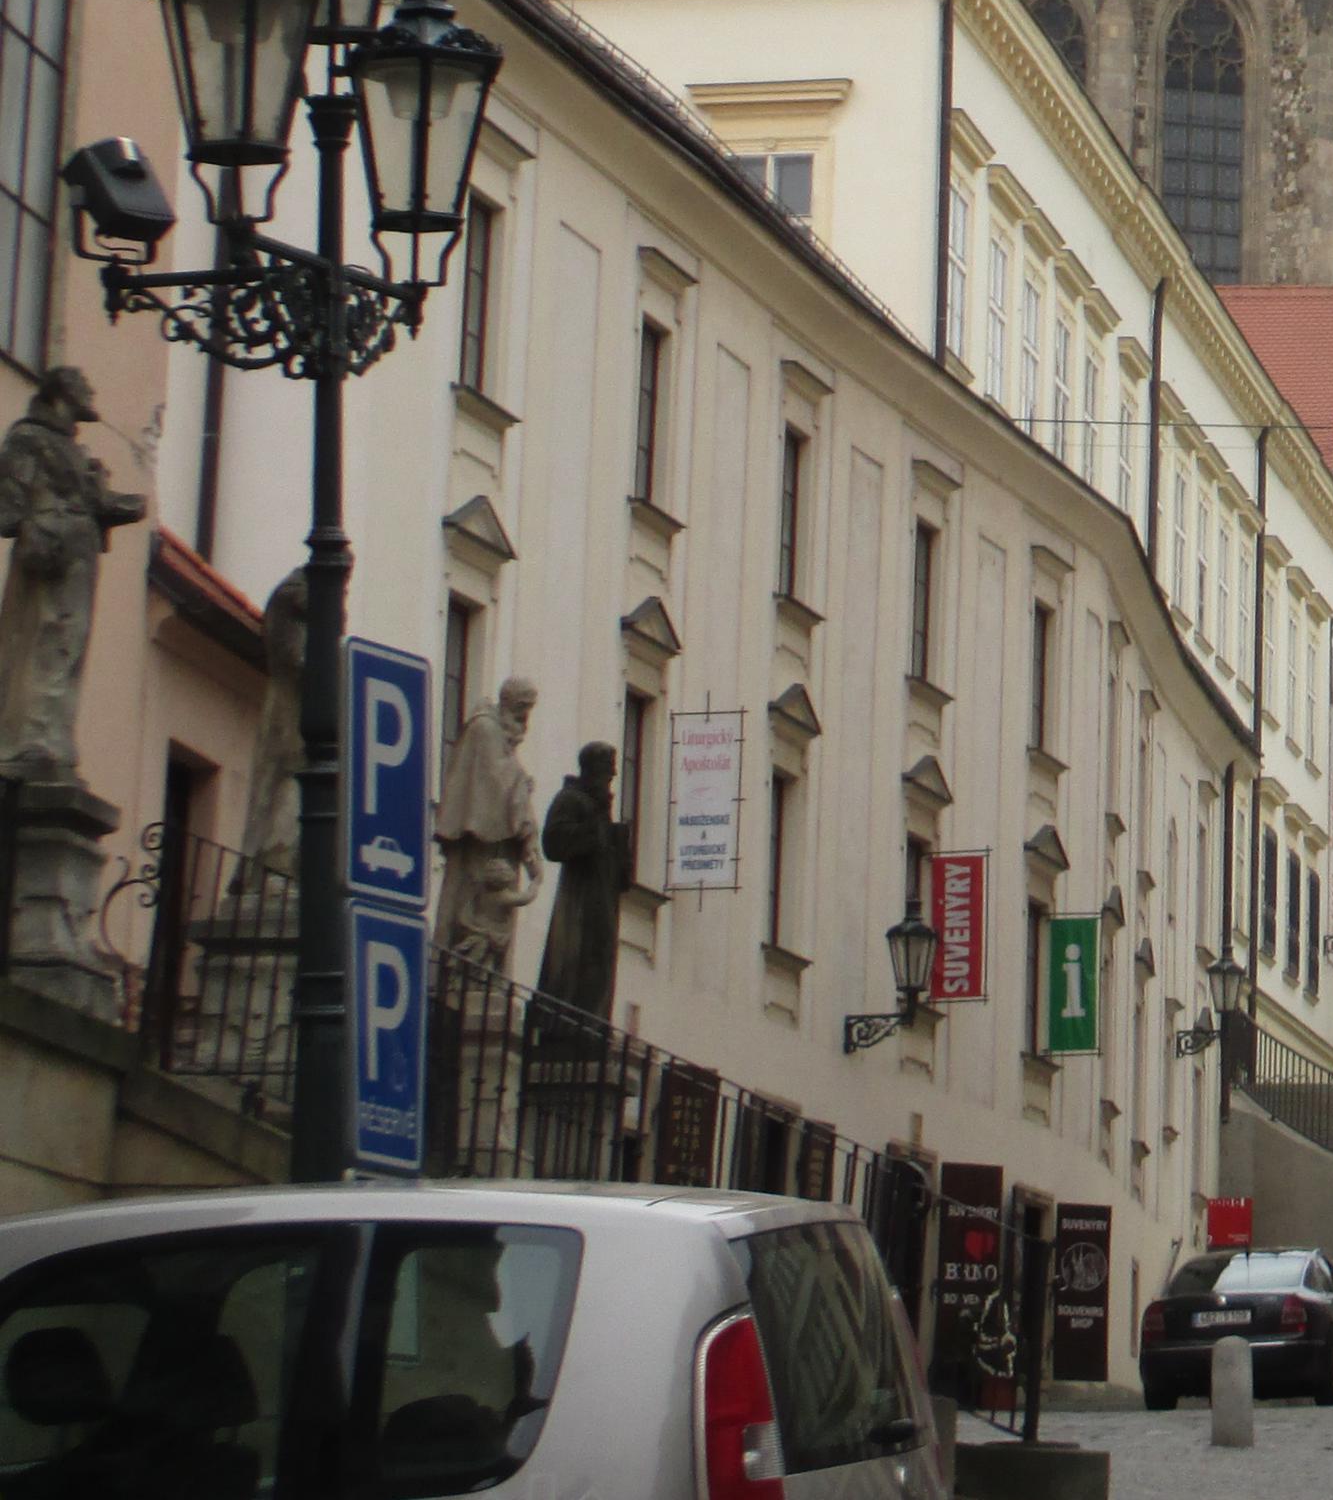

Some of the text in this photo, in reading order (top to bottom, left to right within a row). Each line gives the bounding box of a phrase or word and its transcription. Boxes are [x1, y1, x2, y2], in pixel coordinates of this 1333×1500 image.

[364, 676, 412, 815] P
[940, 863, 972, 994] SUVENÝRY
[365, 941, 410, 1081] P
